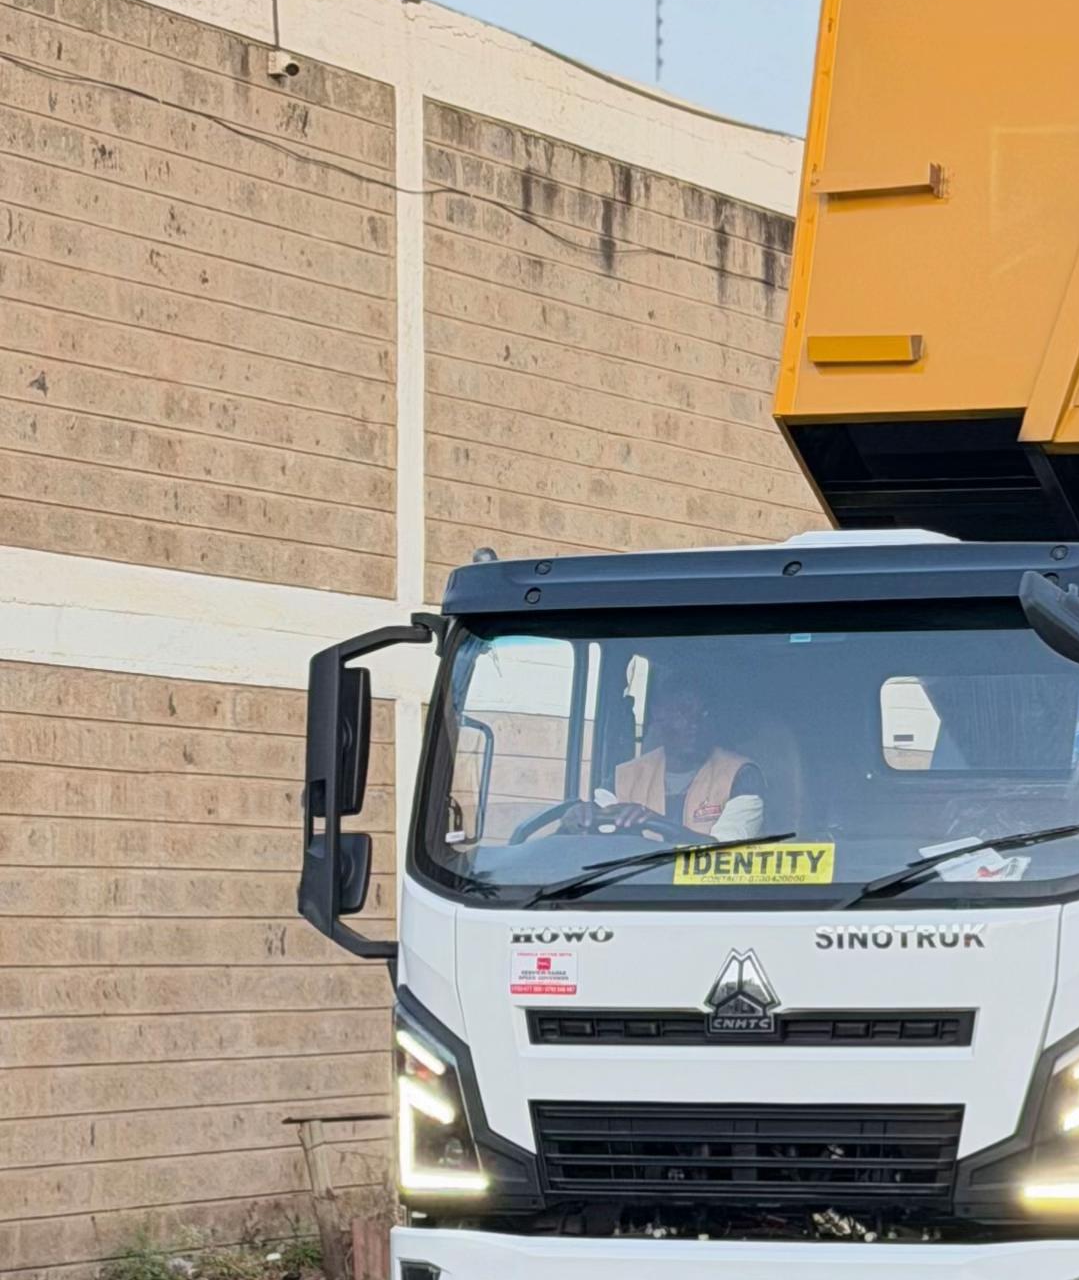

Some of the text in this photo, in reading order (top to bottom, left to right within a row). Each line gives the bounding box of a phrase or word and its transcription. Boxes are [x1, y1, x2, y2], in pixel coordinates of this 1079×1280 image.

[681, 849, 826, 875] IDENTITY
[509, 925, 615, 944] HOWO
[814, 922, 986, 950] SINOTRUK
[712, 1018, 770, 1029] CNHTC
